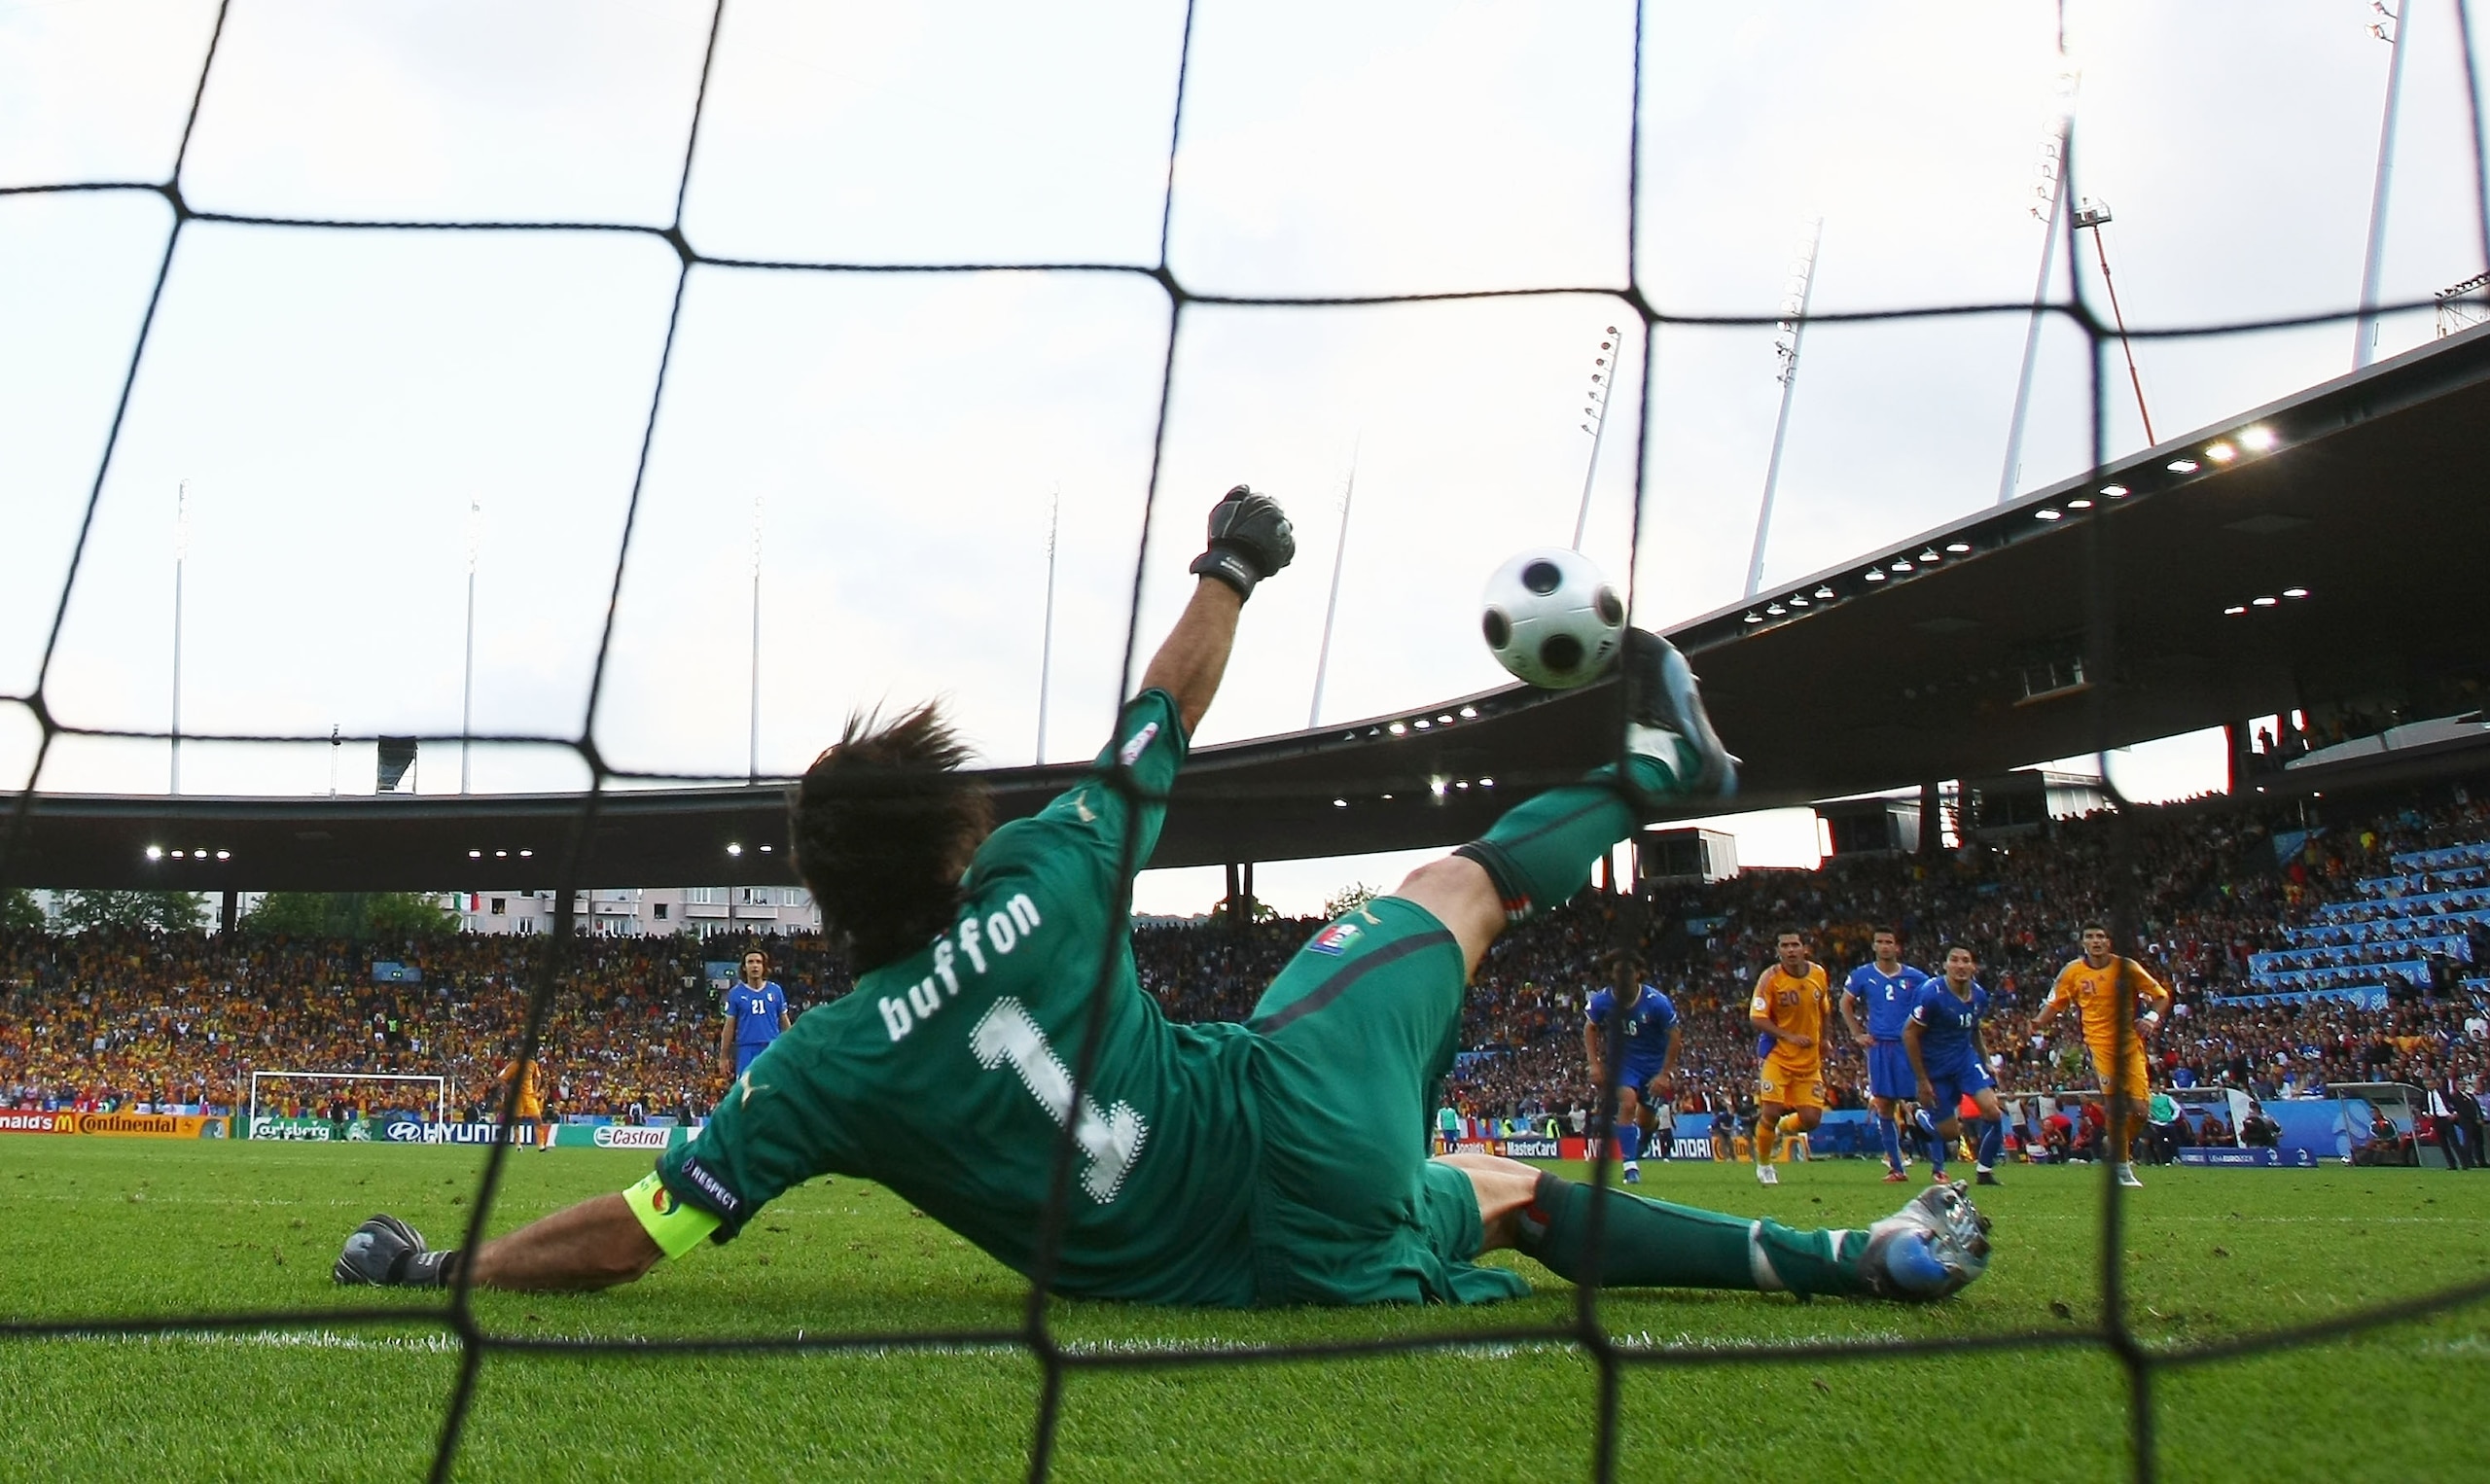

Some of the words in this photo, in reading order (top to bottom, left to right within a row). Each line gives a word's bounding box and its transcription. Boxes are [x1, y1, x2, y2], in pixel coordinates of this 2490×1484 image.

[878, 893, 1041, 1042] buffon
[1885, 984, 1895, 1001] 2
[751, 999, 766, 1014] 21
[969, 996, 1149, 1204] 1
[79, 1114, 176, 1135] Continental
[253, 1115, 331, 1141] Carlsberg
[612, 1125, 665, 1147] Castrol
[1507, 1141, 1557, 1156] MasterCard
[1651, 1138, 1712, 1157] HUNDAI
[691, 1165, 738, 1211] RESPECT
